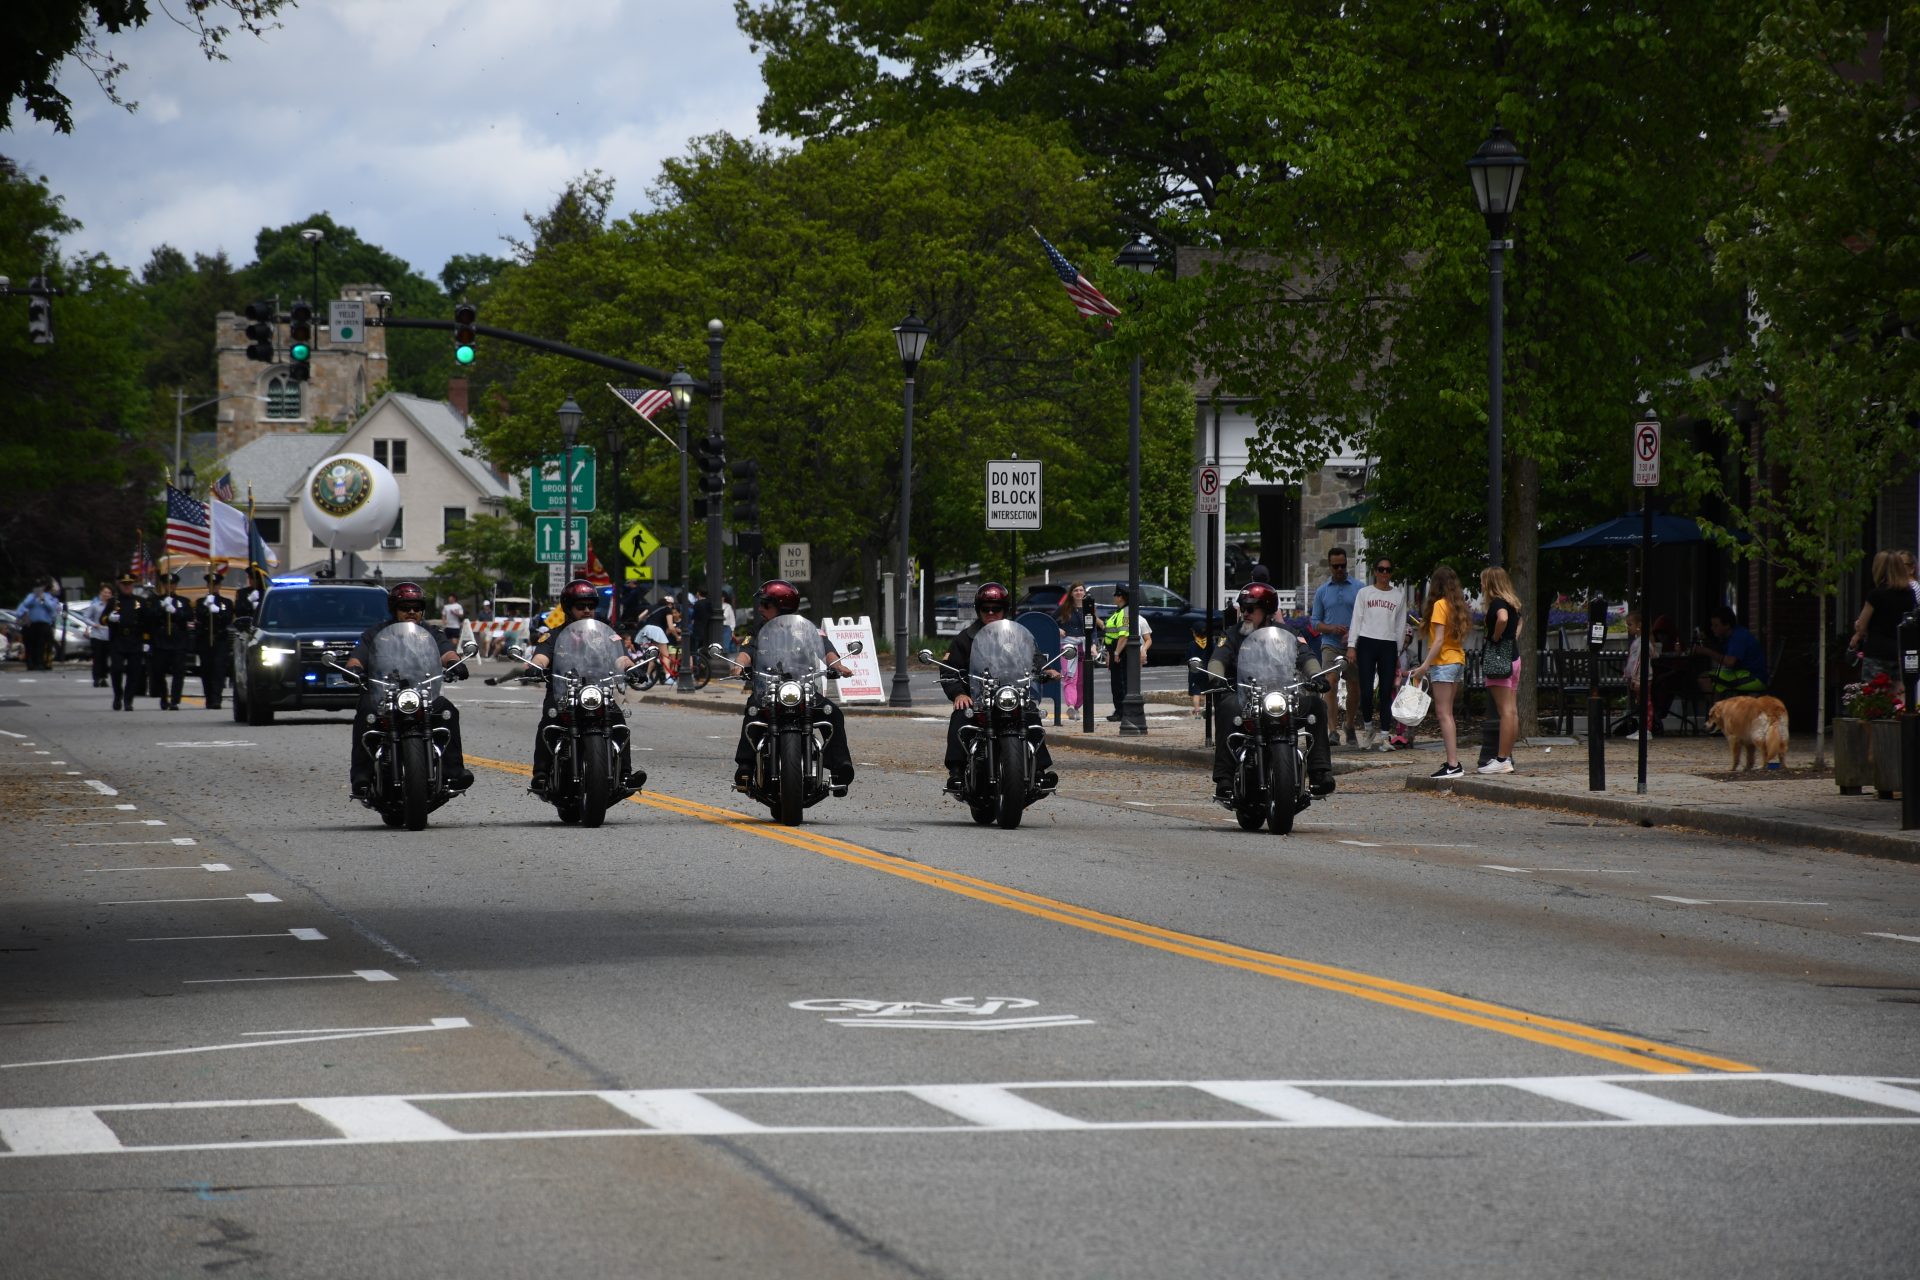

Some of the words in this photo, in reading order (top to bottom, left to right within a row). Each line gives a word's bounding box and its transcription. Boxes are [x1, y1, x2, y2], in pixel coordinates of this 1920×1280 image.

[992, 472, 1008, 486] DO
[1012, 472, 1037, 486] NOT
[542, 484, 583, 493] BROOKINE
[549, 496, 578, 505] BOSTN
[992, 490, 1036, 505] BLOCK
[991, 510, 1037, 520] INTERSECTION
[561, 520, 579, 528] EST
[541, 552, 583, 561] WATERTWN
[788, 547, 802, 557] NO
[785, 559, 804, 567] LEFT
[784, 569, 806, 578] TURN
[1367, 599, 1397, 612] NANTUCKET
[836, 631, 865, 640] PARKING
